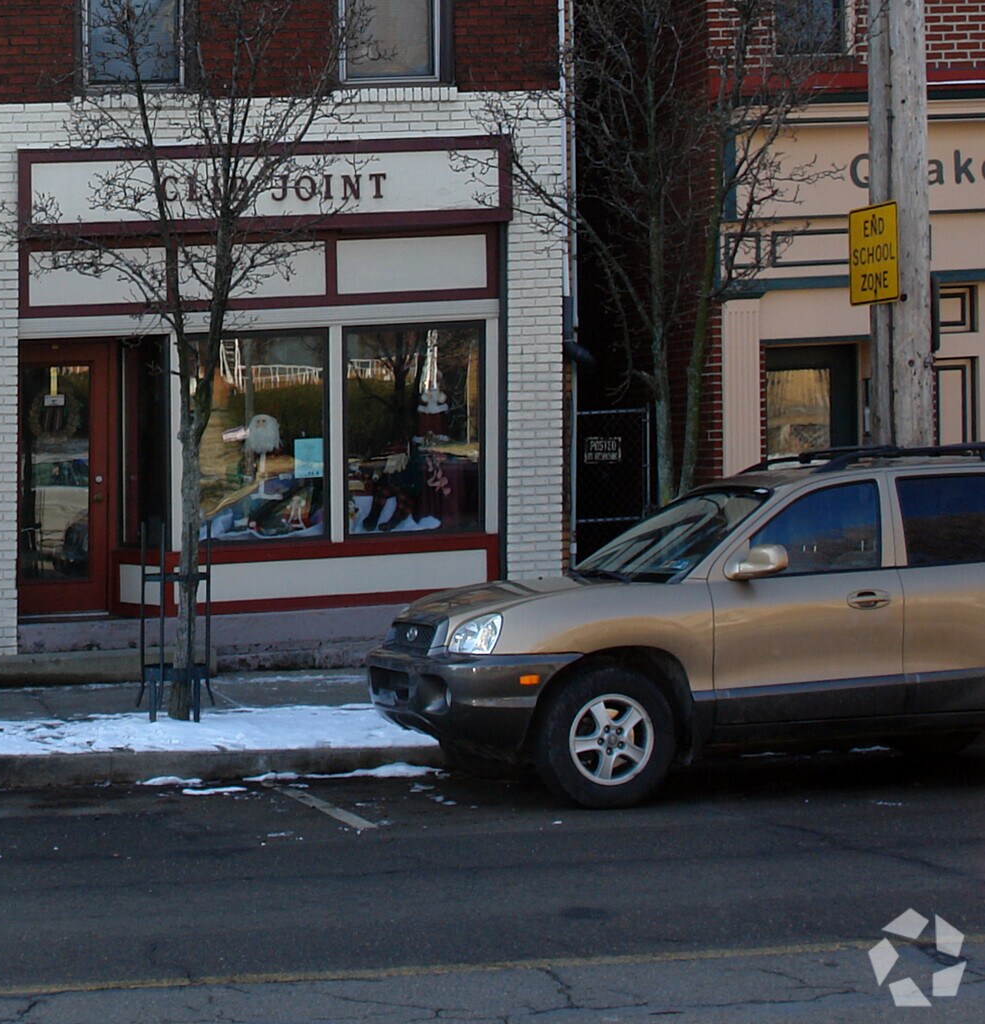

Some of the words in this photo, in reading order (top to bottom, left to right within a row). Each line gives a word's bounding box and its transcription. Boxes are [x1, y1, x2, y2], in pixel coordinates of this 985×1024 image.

[271, 173, 387, 201] JOINT
[863, 217, 885, 237] END
[852, 242, 896, 266] SCHOOL
[860, 270, 889, 292] ZONE
